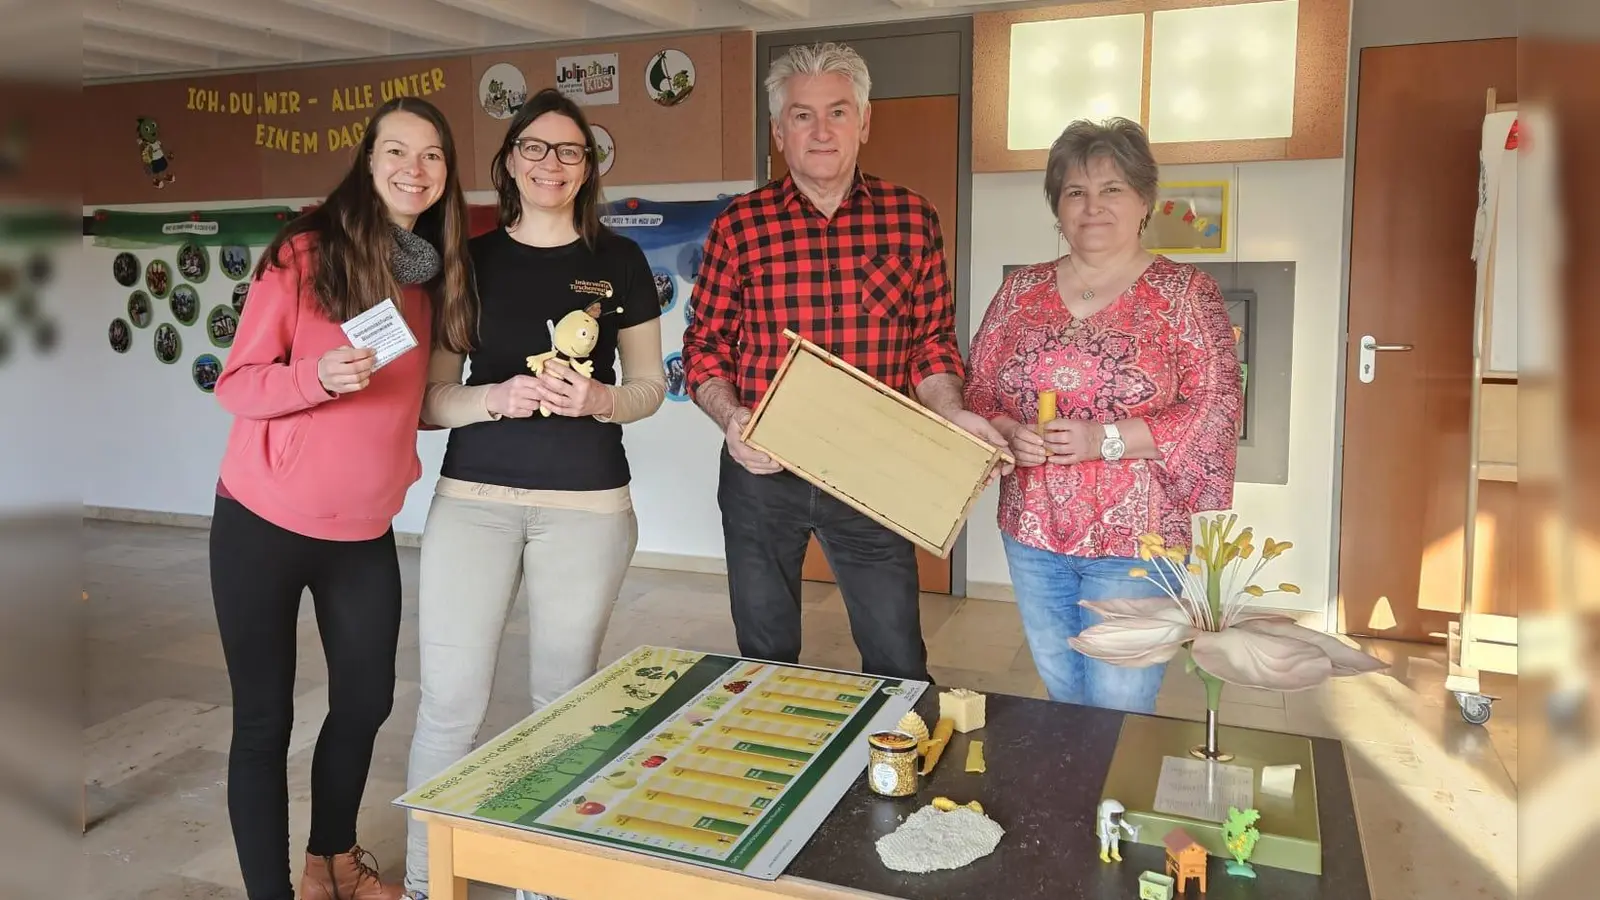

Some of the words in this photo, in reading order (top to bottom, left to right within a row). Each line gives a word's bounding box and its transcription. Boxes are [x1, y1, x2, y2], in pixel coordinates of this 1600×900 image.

[557, 61, 615, 83] Jolinchen
[332, 84, 374, 112] ALLE
[380, 67, 446, 103] UNTER
[588, 77, 610, 91] KIDS
[255, 123, 318, 154] EINEM
[496, 736, 523, 753] ohne
